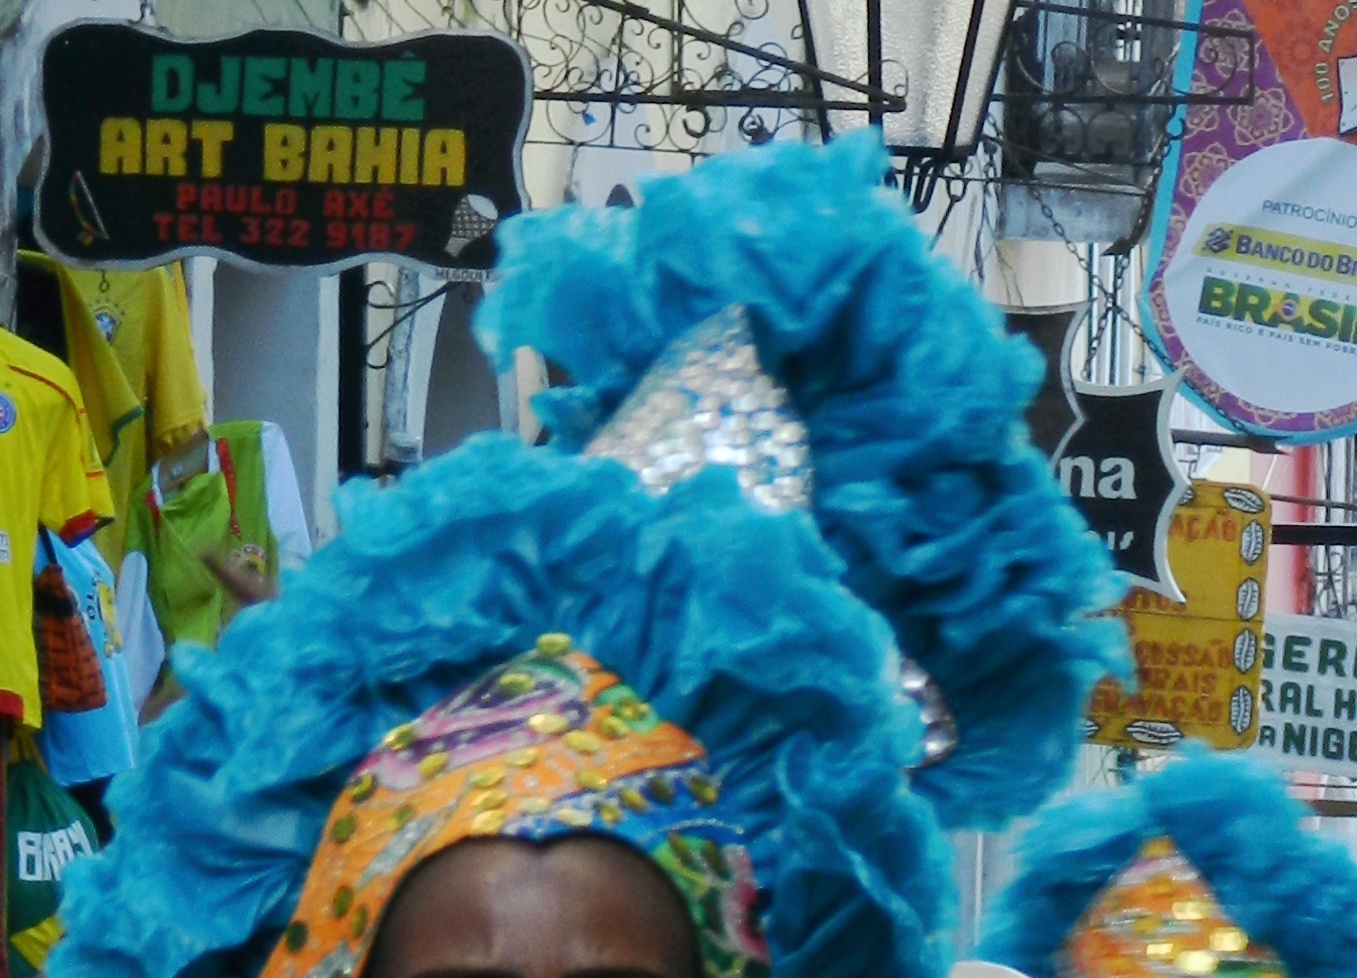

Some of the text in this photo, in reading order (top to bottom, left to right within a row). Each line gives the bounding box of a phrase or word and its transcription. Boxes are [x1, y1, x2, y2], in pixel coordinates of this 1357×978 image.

[100, 117, 466, 186] ART BAHIA
[177, 184, 298, 215] PAULO
[154, 212, 416, 250] TEL 322 9187
